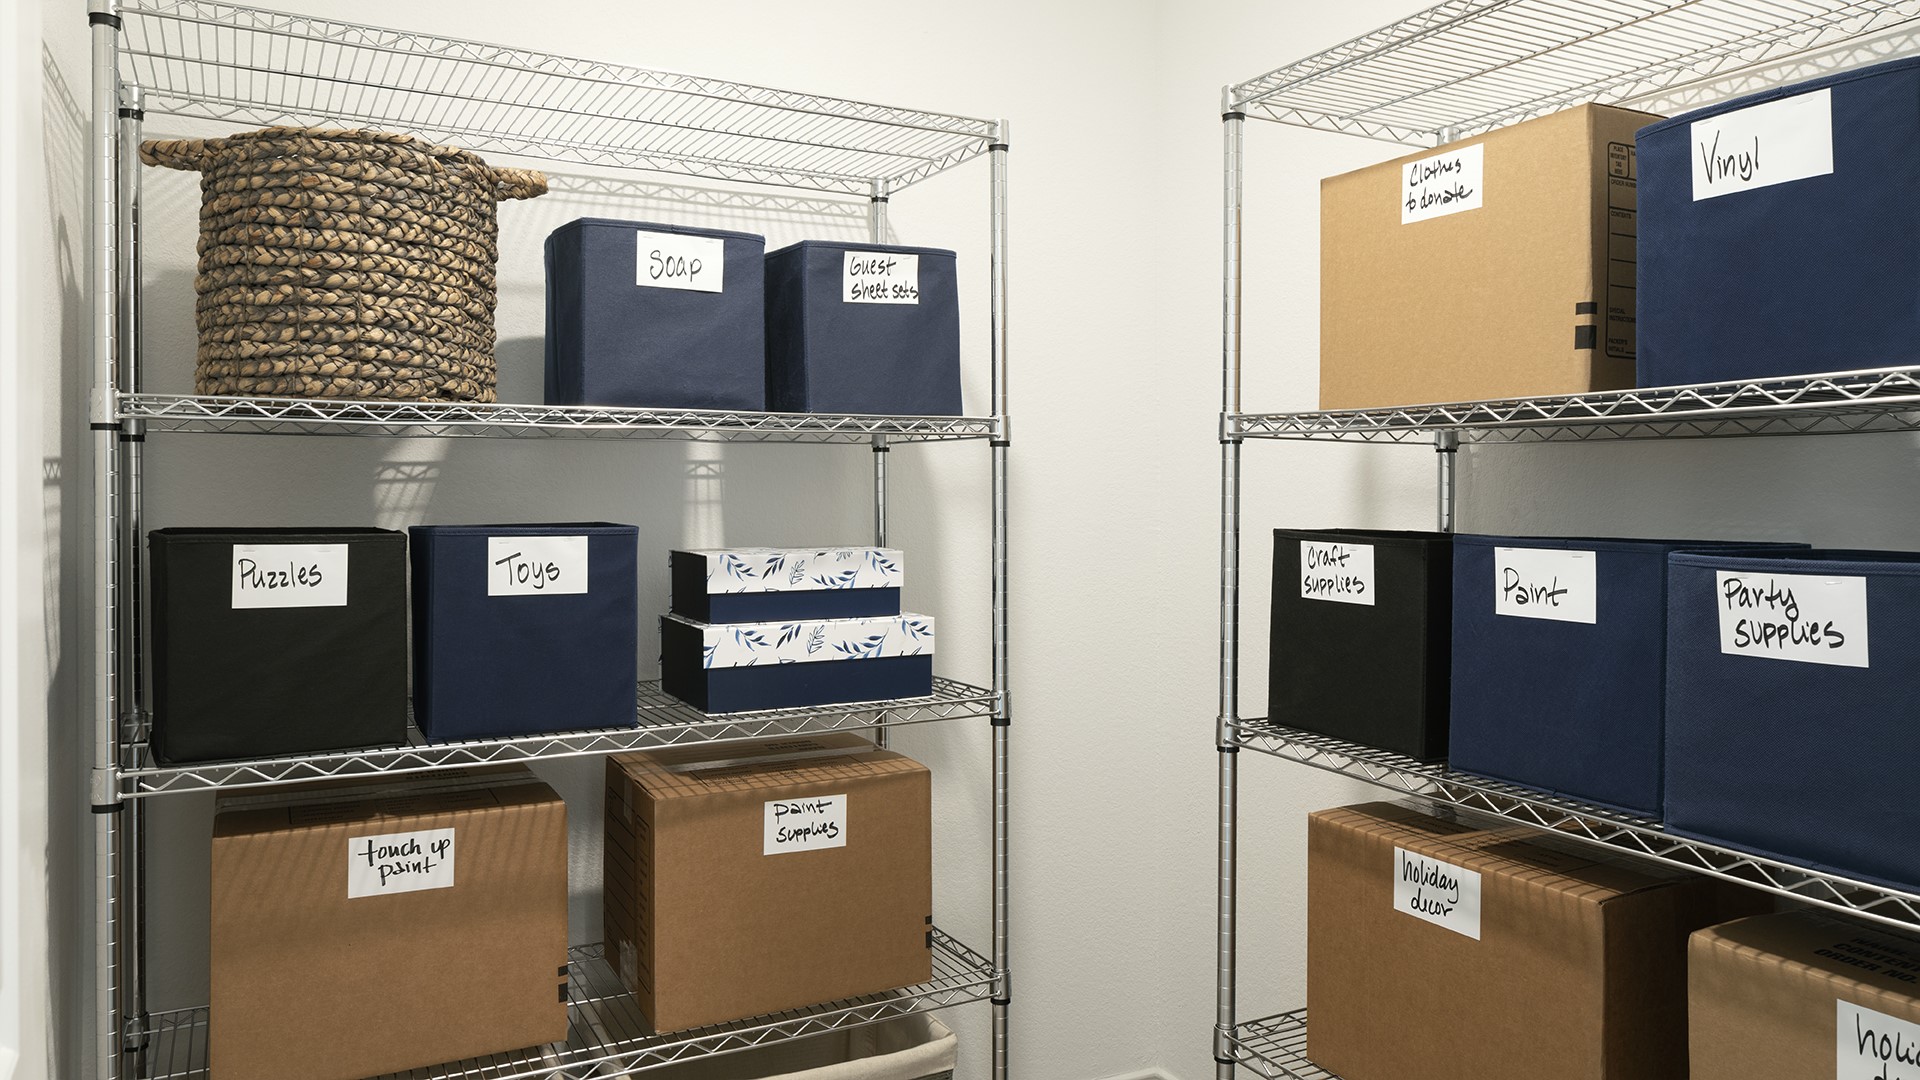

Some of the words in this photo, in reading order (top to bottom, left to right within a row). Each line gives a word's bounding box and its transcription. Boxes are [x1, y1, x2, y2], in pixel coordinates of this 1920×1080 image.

[1701, 129, 1759, 184] Vinyl
[1409, 157, 1463, 187] Clothes
[1405, 193, 1418, 212] to
[1420, 182, 1473, 209] donate
[649, 249, 702, 282] Soap
[850, 256, 897, 277] Guest
[851, 279, 889, 300] sheet
[891, 280, 919, 300] sets
[495, 552, 561, 590] Toys
[1307, 545, 1351, 570] Craft
[238, 558, 323, 590] Puzzles
[1303, 573, 1365, 595] supplies
[1503, 567, 1568, 606] Paint
[1723, 577, 1798, 619] Party
[1734, 617, 1845, 649] supplies
[773, 799, 833, 824] paint
[775, 820, 839, 843] supplies
[357, 838, 422, 868] touch
[430, 838, 451, 860] up
[377, 856, 438, 887] paint
[1402, 849, 1461, 904] holiday
[1410, 887, 1454, 917] decor
[1813, 948, 1883, 972] ORDER
